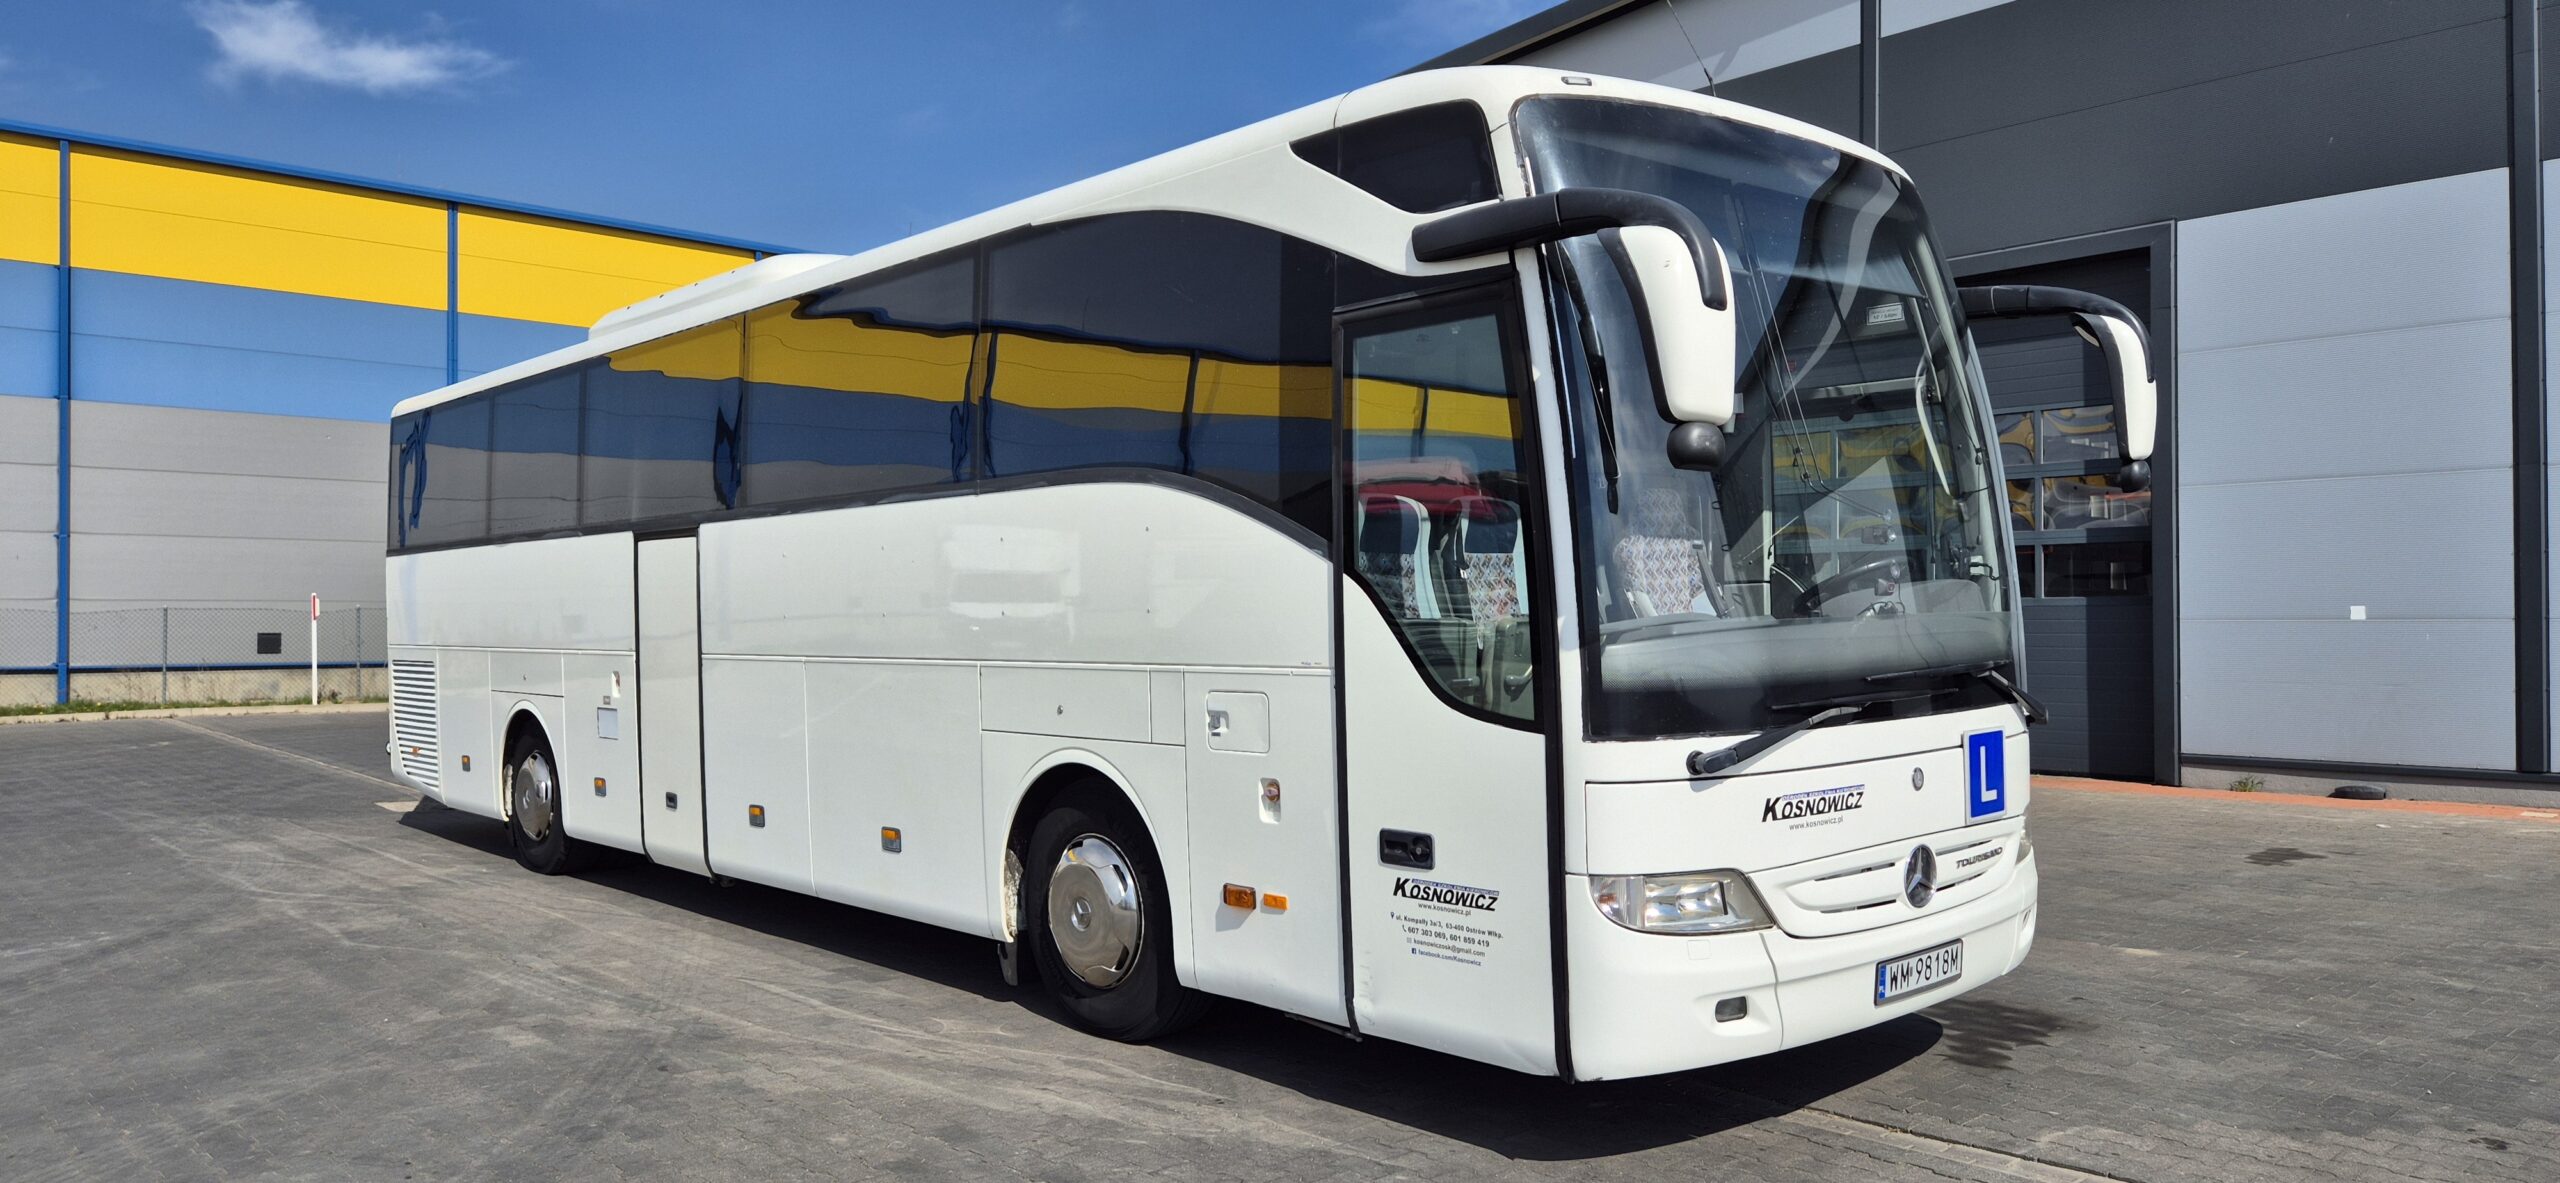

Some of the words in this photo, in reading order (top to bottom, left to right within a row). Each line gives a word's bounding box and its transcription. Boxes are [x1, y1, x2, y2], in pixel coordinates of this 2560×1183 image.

[1980, 745, 1997, 803] L
[1762, 791, 1864, 822] KOSNOWICZ
[1789, 816, 1843, 830] www.kosnowicz.pl
[1956, 847, 2003, 869] TOURISMO
[1393, 877, 1499, 911] KOSNOWICZ
[1418, 902, 1471, 916] www.kosnowicz.pl
[1408, 926, 1419, 934] 607
[1421, 928, 1433, 937] 303
[1450, 933, 1461, 942] 601
[1463, 935, 1475, 945] 859
[1477, 938, 1490, 948] 419
[1446, 922, 1464, 931] 63-400
[1413, 938, 1485, 957] kosnowiczosk@gmail.com
[1418, 949, 1482, 966] facebook.com/Kosnowicz
[1890, 961, 1910, 993] WM
[1915, 945, 1958, 985] 9818M
